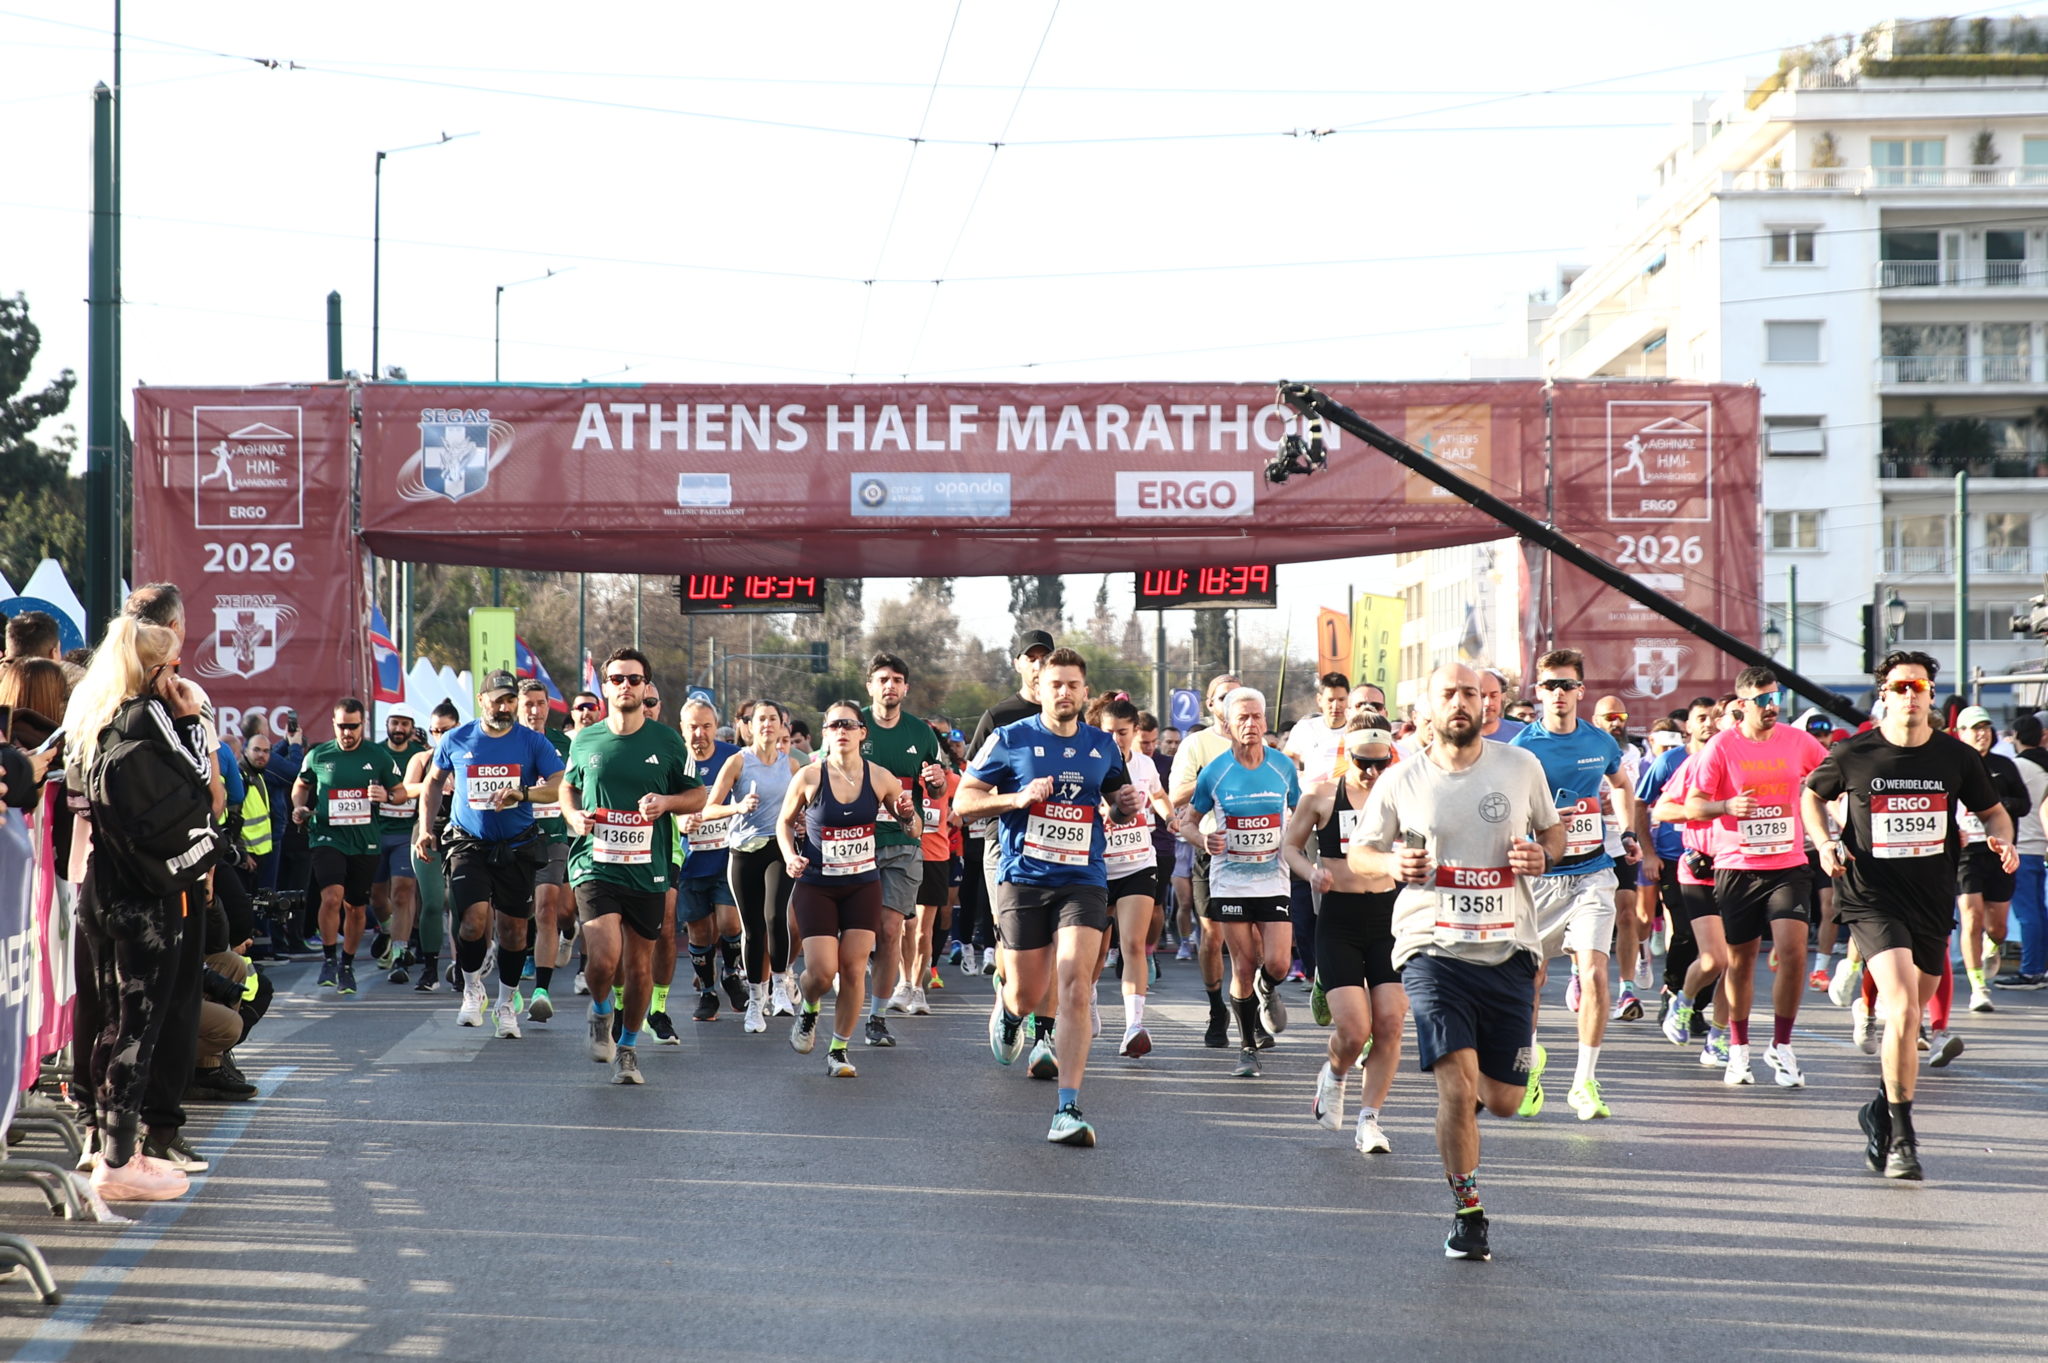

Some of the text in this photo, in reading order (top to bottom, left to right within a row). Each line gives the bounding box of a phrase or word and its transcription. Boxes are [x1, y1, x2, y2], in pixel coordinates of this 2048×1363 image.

[421, 408, 490, 423] SEGAS
[571, 402, 808, 451] ATHENS
[826, 403, 979, 451] HALF
[236, 444, 287, 456] ΑΘΗΝΑΣ
[1442, 447, 1475, 460] HALF
[1137, 481, 1238, 510] ERGO
[229, 506, 267, 519] ERGO
[1641, 499, 1678, 512] ERGO
[1615, 535, 1704, 564] 2026
[203, 542, 295, 572] 2026
[215, 594, 277, 608] ΣΕΓΑΣ
[1177, 693, 1191, 719] 2
[477, 766, 509, 776] ERGO
[1741, 758, 1788, 771] WALK
[474, 781, 513, 792] 13044
[1886, 779, 1945, 791] WERIDELOCAL
[337, 790, 362, 798] ERGO
[337, 801, 362, 811] 9291
[1887, 797, 1931, 811] ERGO
[607, 811, 642, 825] ERGO
[1045, 804, 1083, 820] ERGO
[1237, 817, 1270, 829] ERGO
[1747, 822, 1787, 836] 13789
[1884, 816, 1936, 833] 13594
[602, 829, 645, 844] 13666
[834, 827, 864, 839] ERGO
[1038, 823, 1084, 841] 12958
[1107, 831, 1142, 846] 13798
[1234, 832, 1274, 846] 13732
[166, 835, 215, 875] PUMA
[831, 841, 869, 857] 13704
[1454, 869, 1501, 887] ERGO
[1448, 894, 1503, 914] 13581
